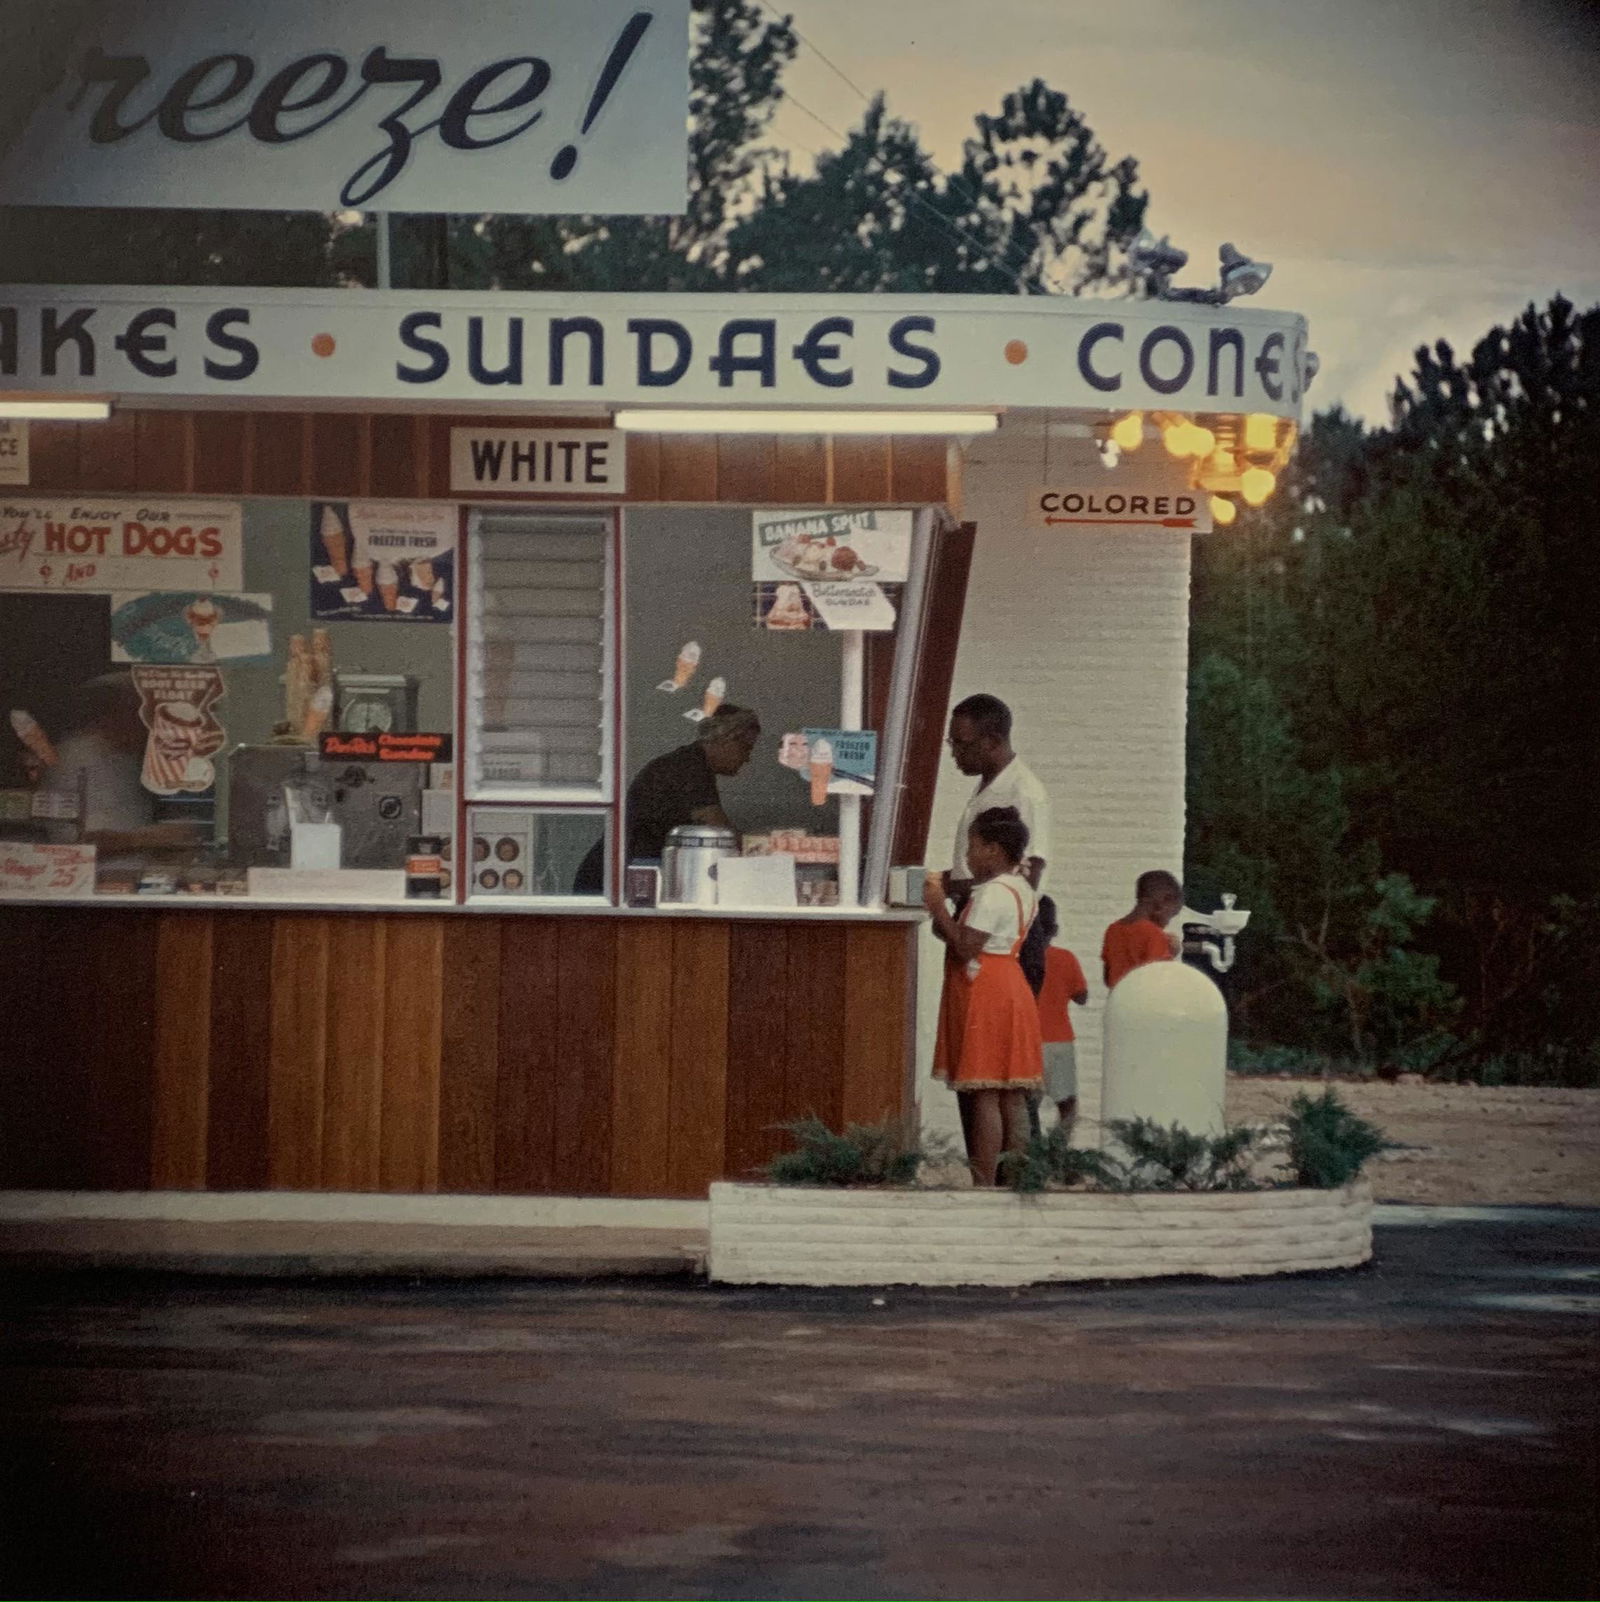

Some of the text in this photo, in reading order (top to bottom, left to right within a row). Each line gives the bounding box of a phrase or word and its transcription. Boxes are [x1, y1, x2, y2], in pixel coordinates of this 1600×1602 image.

[396, 311, 943, 389] SUNDAES
[471, 439, 609, 483] WHITE
[70, 506, 121, 520] ENJOY
[136, 508, 170, 521] OUR
[1040, 492, 1196, 515] COLORED
[45, 522, 111, 554] HOT
[123, 522, 223, 557] DOGS
[368, 535, 438, 548] FREEZER FRESH
[764, 518, 829, 542] BANANA
